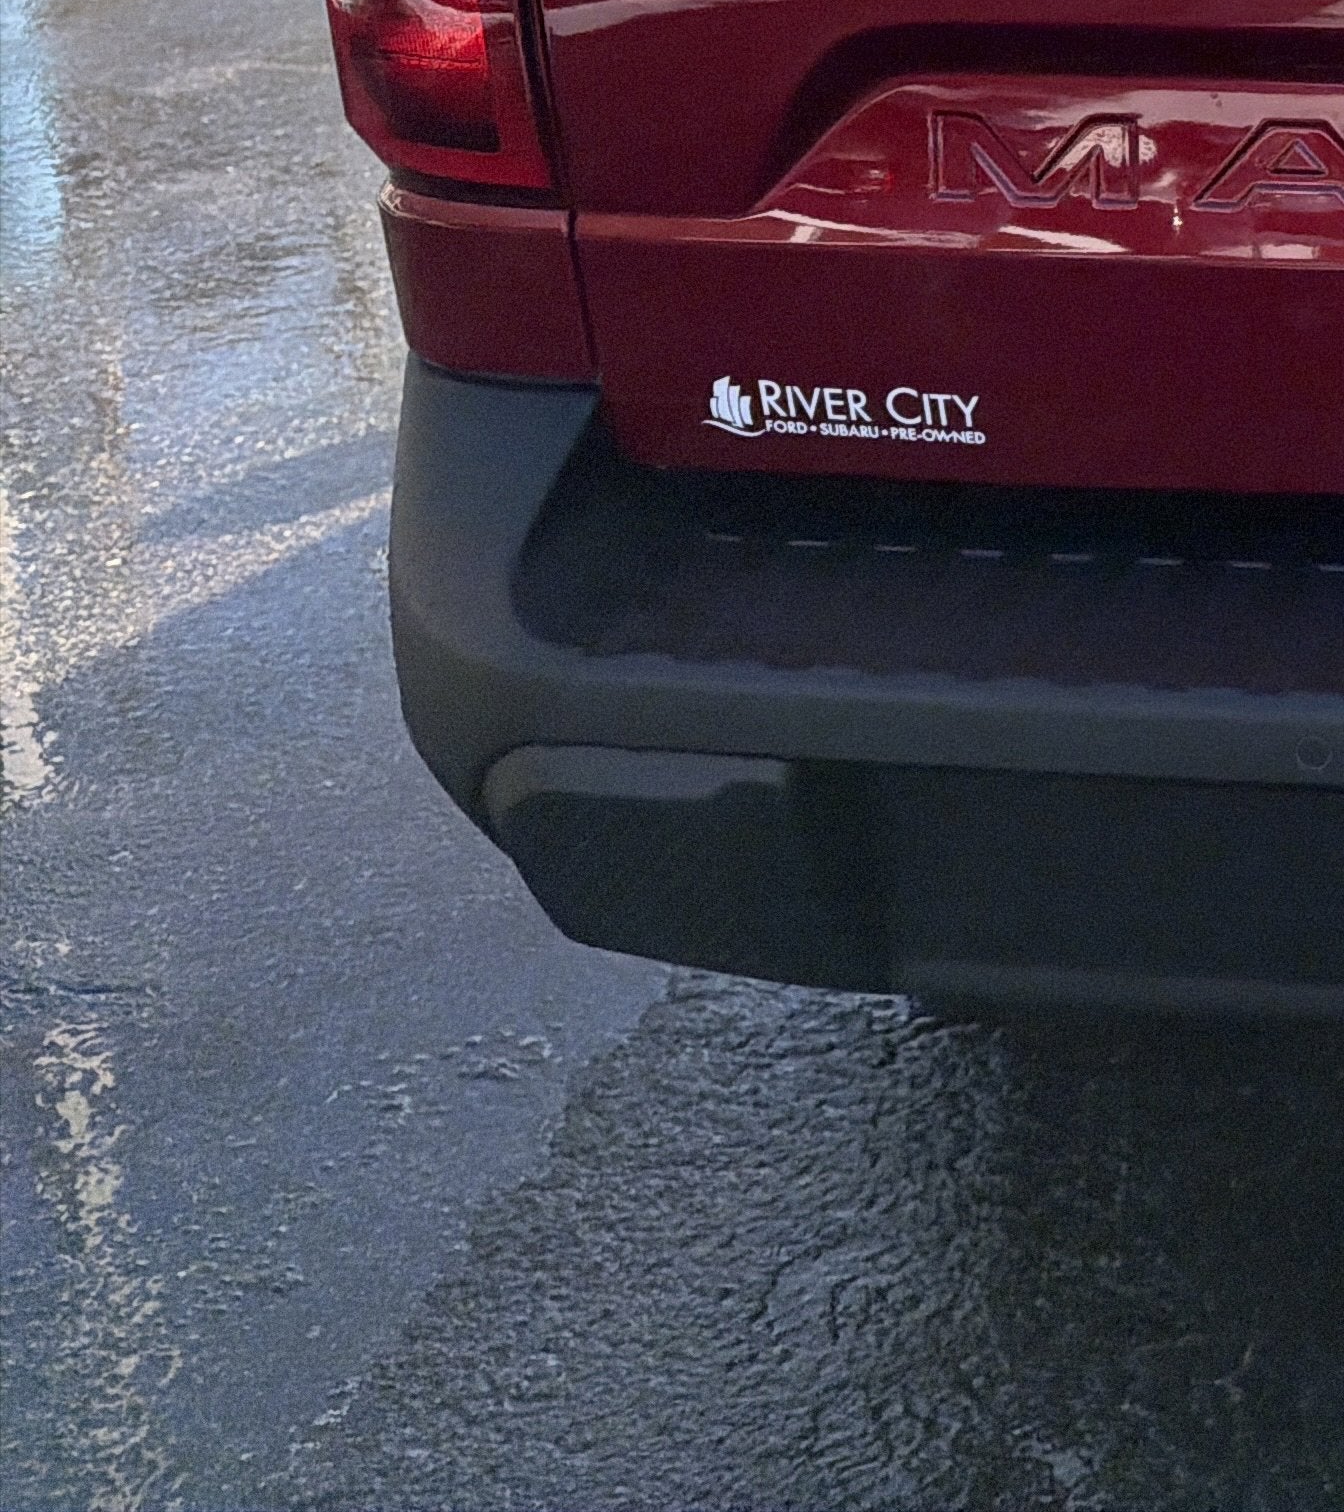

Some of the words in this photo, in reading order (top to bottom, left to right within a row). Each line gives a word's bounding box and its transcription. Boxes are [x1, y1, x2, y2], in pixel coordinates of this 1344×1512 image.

[757, 379, 873, 422] RIVER
[885, 386, 980, 428] CITY
[764, 419, 808, 434] FORD
[819, 423, 880, 439] SUBARU
[890, 426, 987, 445] PRE-OWNED
